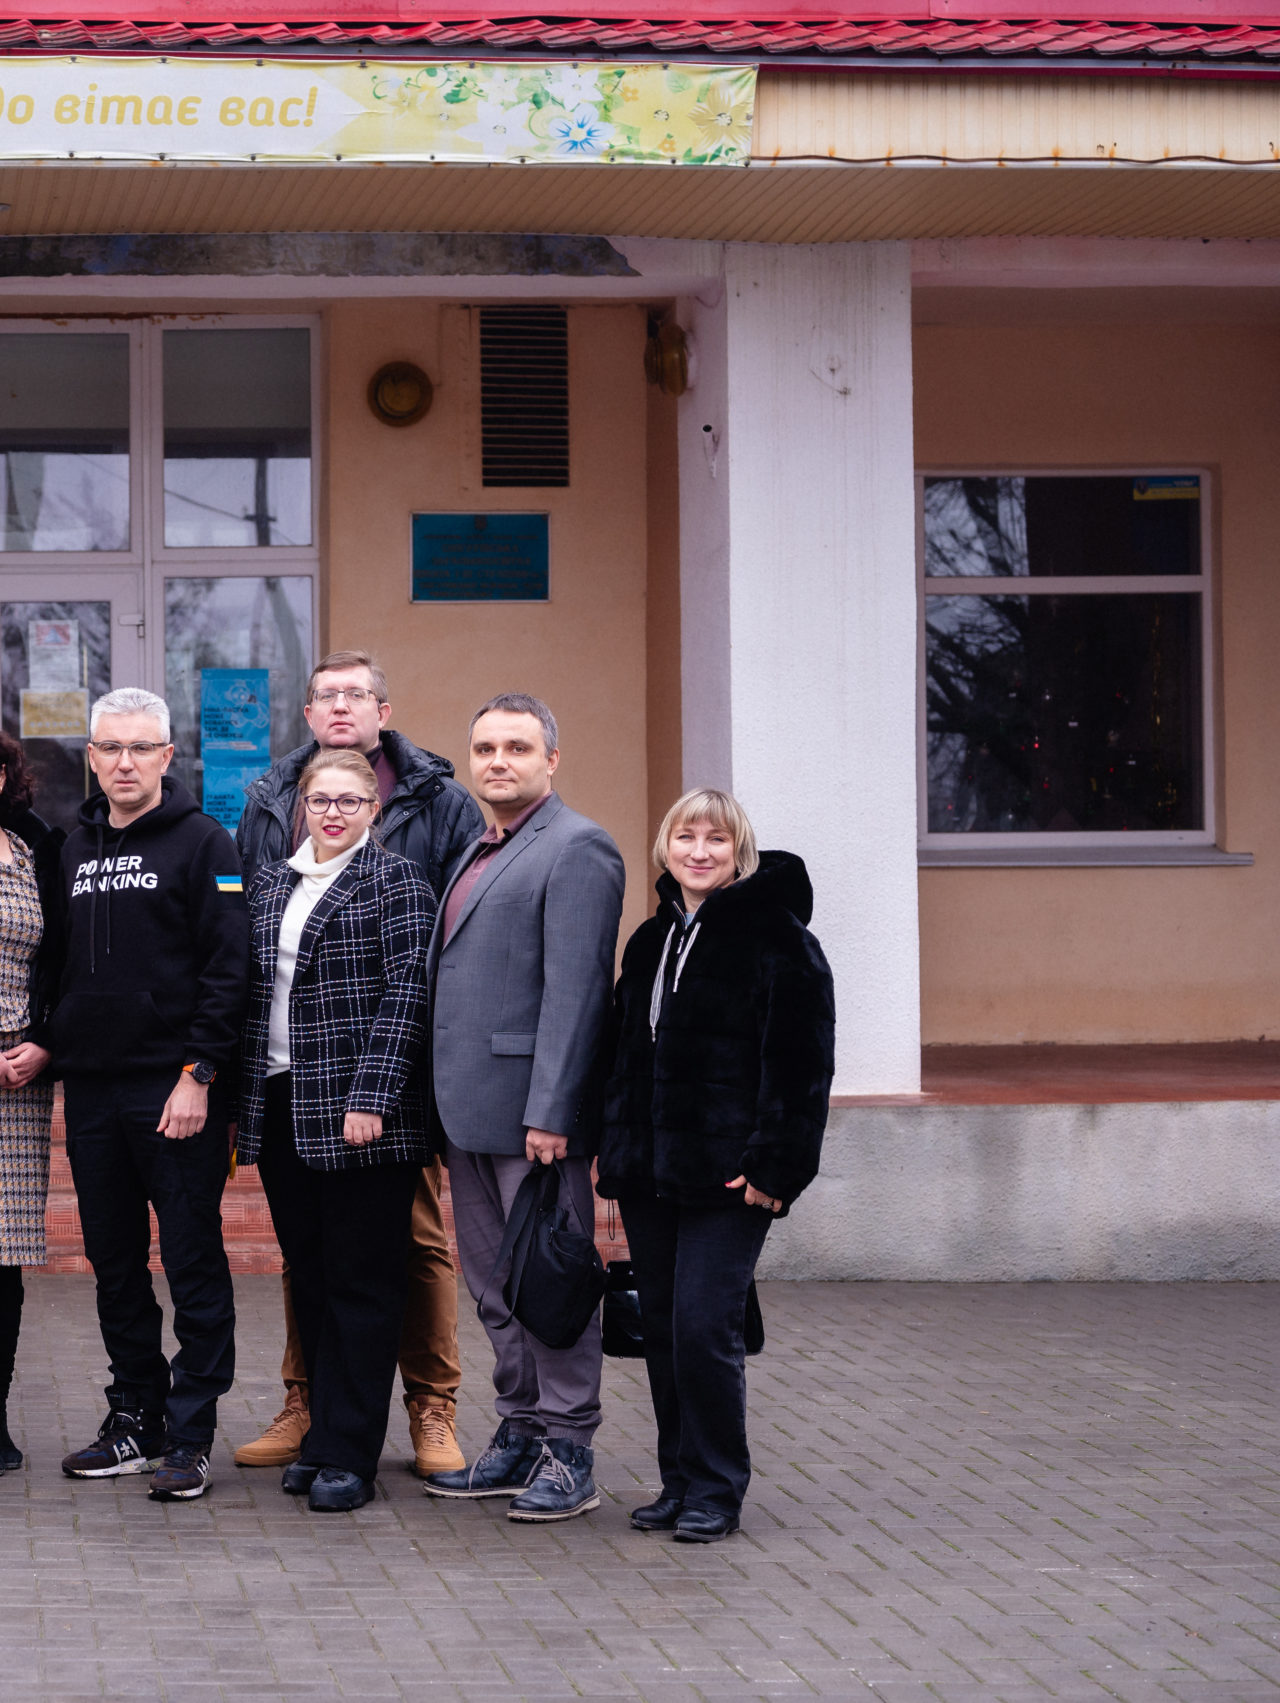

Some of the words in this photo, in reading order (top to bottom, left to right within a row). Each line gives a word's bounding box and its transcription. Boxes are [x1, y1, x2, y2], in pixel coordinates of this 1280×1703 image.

[54, 83, 203, 125] вітає
[219, 86, 318, 128] вас!
[75, 855, 143, 879] POWER
[71, 872, 158, 898] BANKING
